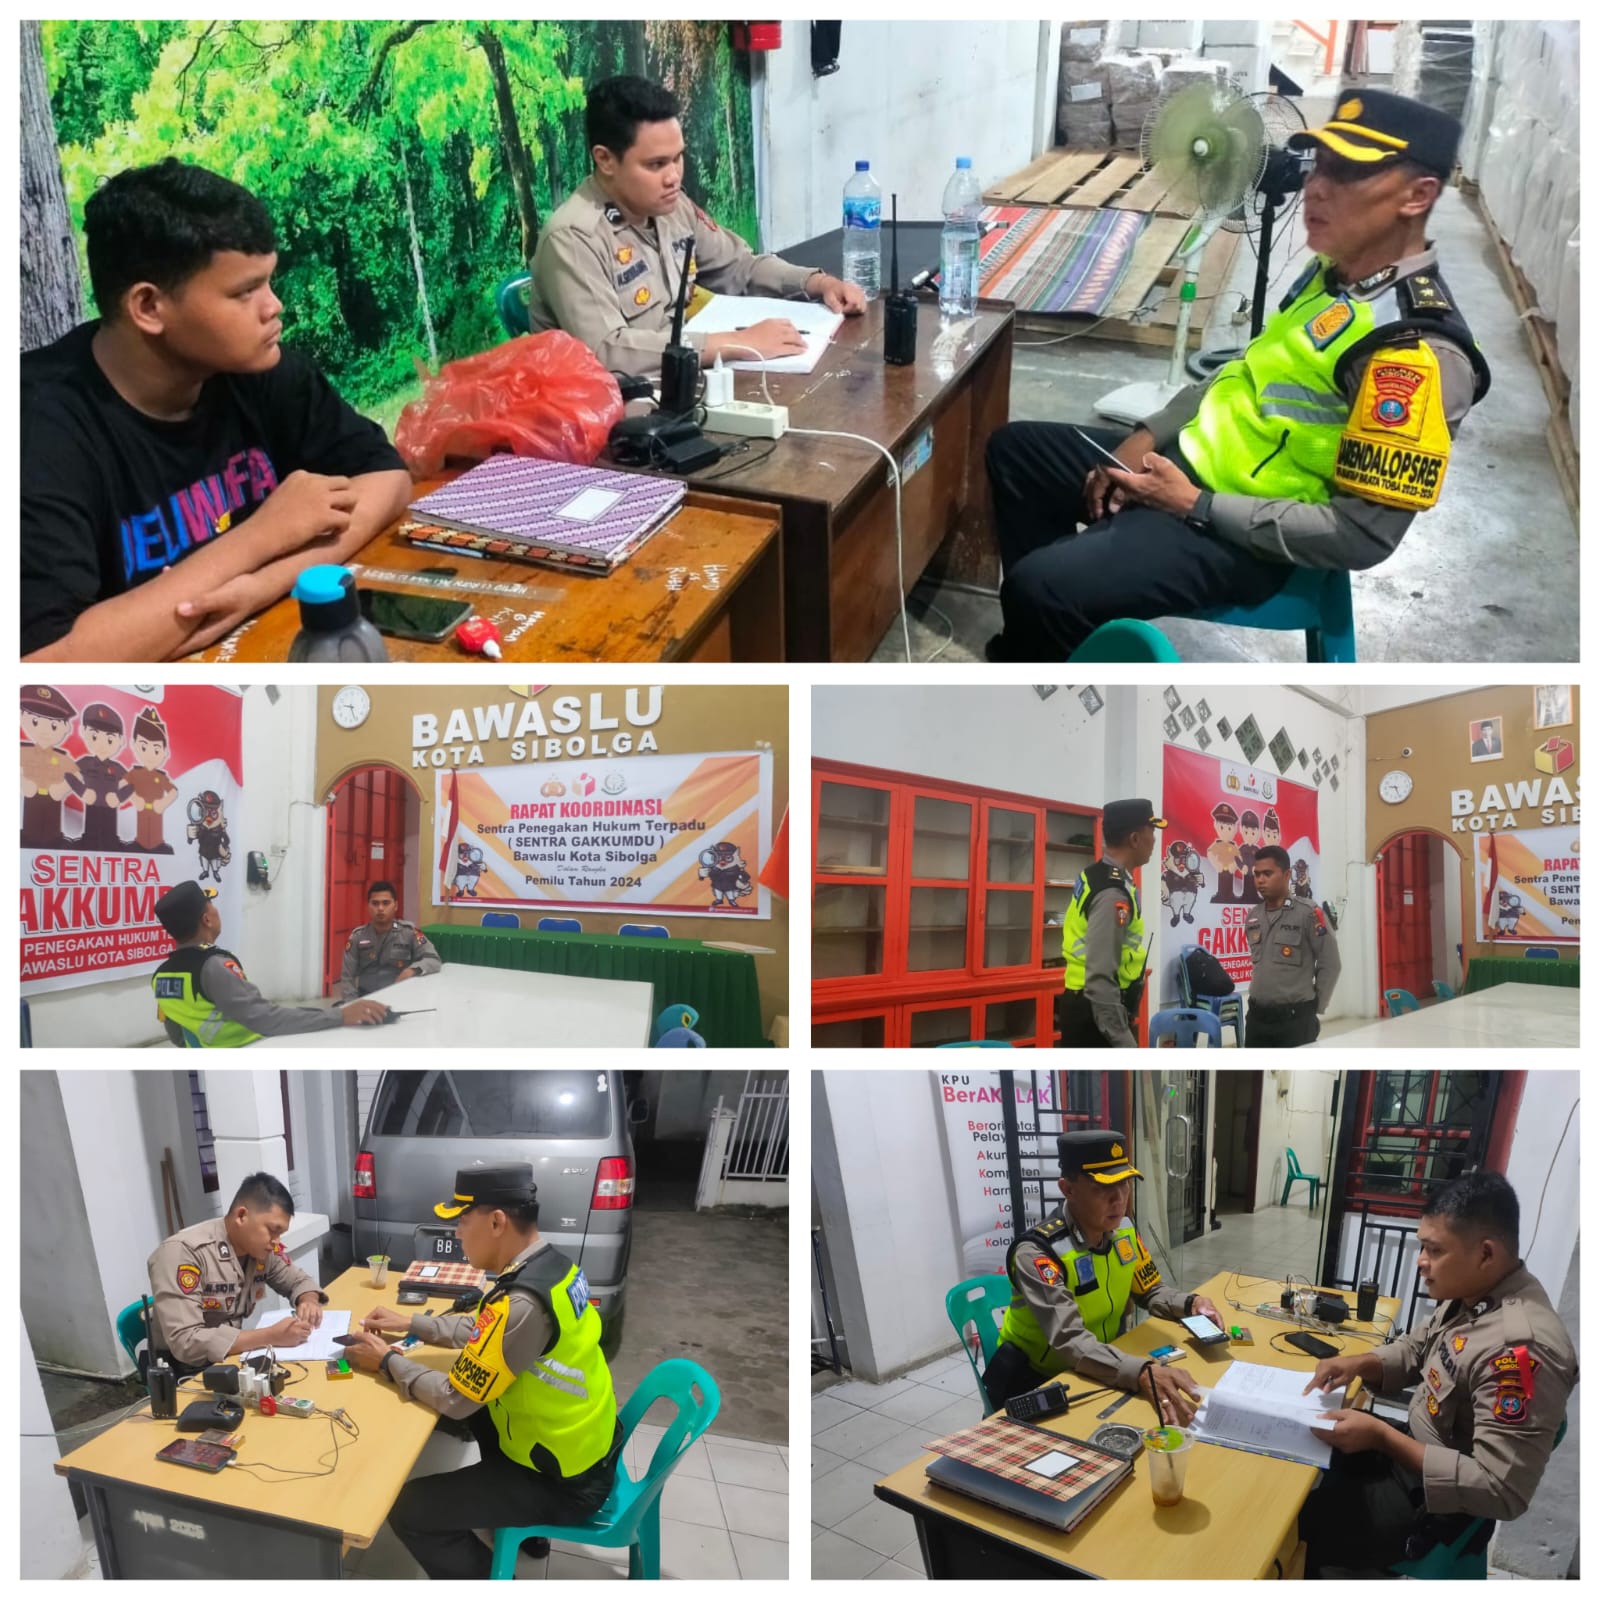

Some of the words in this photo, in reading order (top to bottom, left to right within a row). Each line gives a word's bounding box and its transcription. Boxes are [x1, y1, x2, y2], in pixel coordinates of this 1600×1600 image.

[412, 685, 664, 748] BAWASLU
[412, 745, 485, 768] KOTA
[511, 731, 659, 761] SIBOLGA
[510, 802, 556, 819] RAPAT
[560, 799, 662, 818] KOORDINASI
[477, 823, 515, 834] Sentra
[519, 822, 588, 835] Penegakan
[592, 820, 640, 832] Hukum
[645, 819, 706, 834] Terpadu
[1452, 812, 1518, 832] KOTA
[515, 837, 567, 847] SENTRA
[571, 836, 655, 847] GAKKUMDU
[513, 851, 566, 862] Bawaslu
[570, 851, 601, 862] Kota
[605, 851, 657, 864] Sibolga
[1543, 857, 1580, 871] RAPA
[32, 854, 161, 884] SENTRA
[525, 875, 564, 886] Pemilu
[568, 876, 606, 887] Tahun
[610, 877, 642, 888] 2024
[1514, 875, 1549, 884] Sentra
[24, 935, 114, 957] PENEGAKAN
[118, 930, 159, 945] HUKUM
[21, 955, 84, 976] AWASLU
[88, 950, 126, 966] KOTA
[127, 943, 174, 961] SIBOLGA
[941, 1074, 971, 1086] KPU
[943, 1086, 1050, 1104] BerAKLAK
[998, 1201, 1028, 1213] Lol
[436, 1239, 452, 1254] BB
